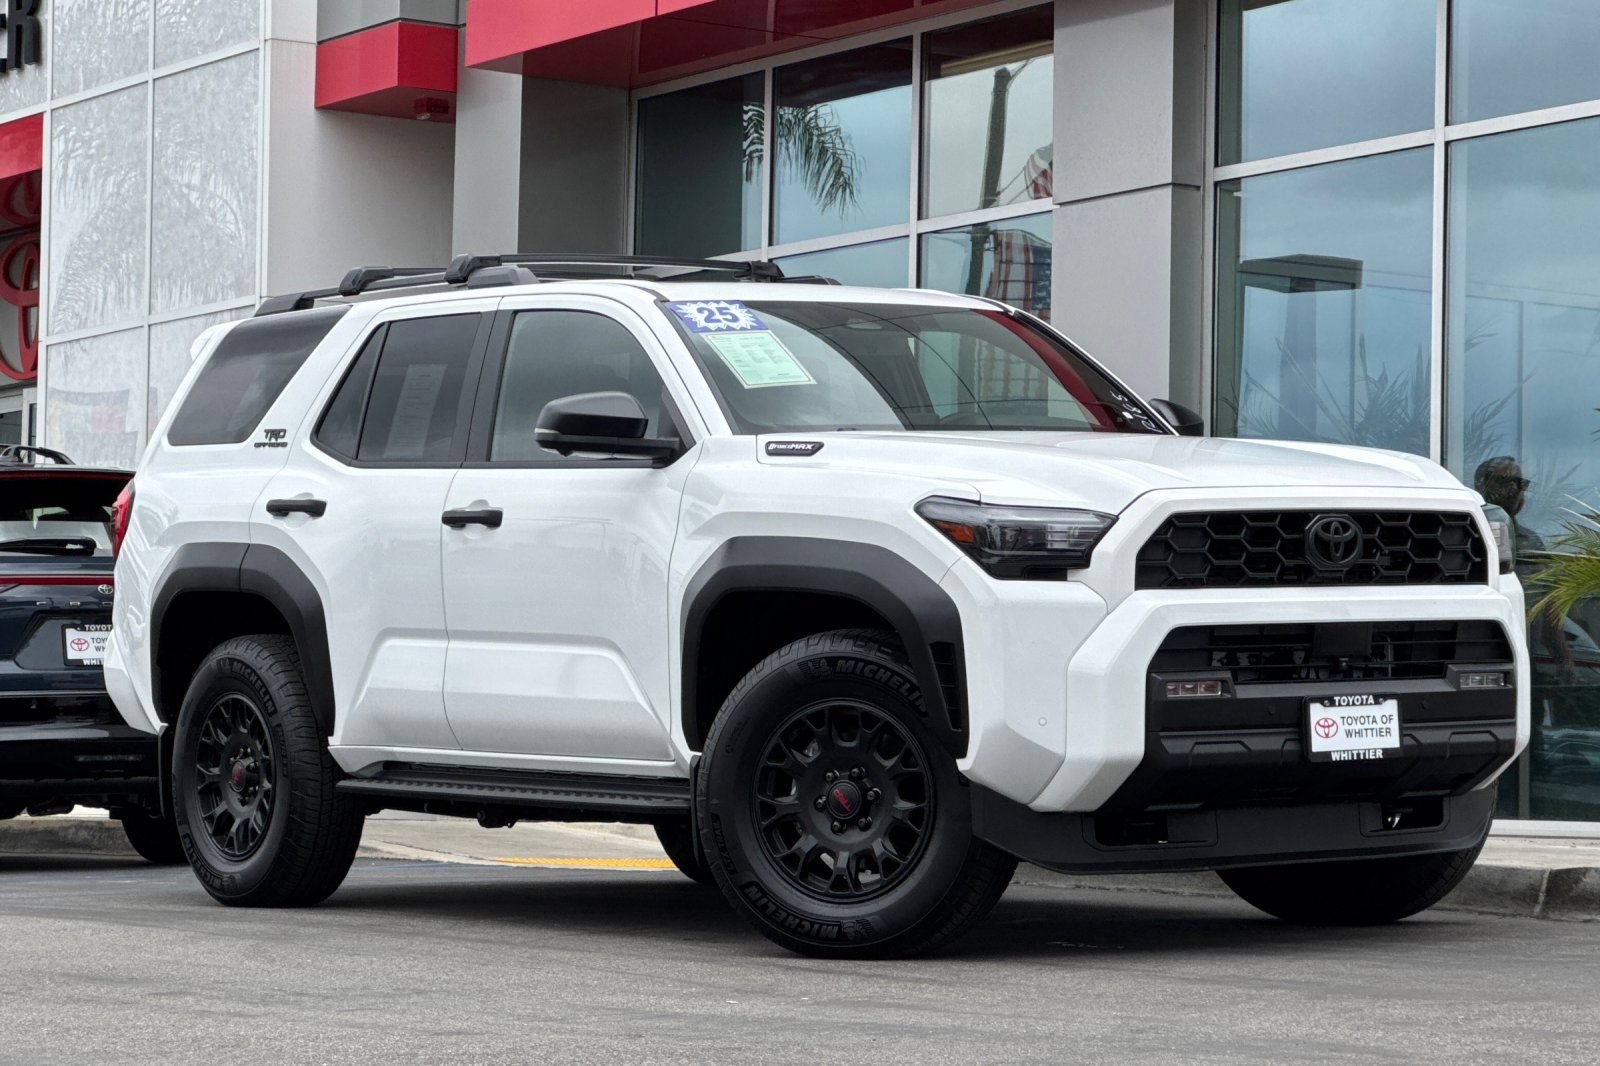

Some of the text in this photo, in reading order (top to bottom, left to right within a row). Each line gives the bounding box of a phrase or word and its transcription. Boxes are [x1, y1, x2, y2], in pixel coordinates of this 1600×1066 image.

[696, 307, 740, 323] 25
[264, 428, 287, 441] TRD
[231, 663, 278, 717] MICHELIN
[1333, 695, 1375, 706] TOYOTA
[1340, 714, 1394, 726] TOYOTA OF
[1345, 727, 1392, 739] WHITTIER
[1331, 749, 1383, 761] WHITTIER
[742, 882, 842, 939] MICHELIN
